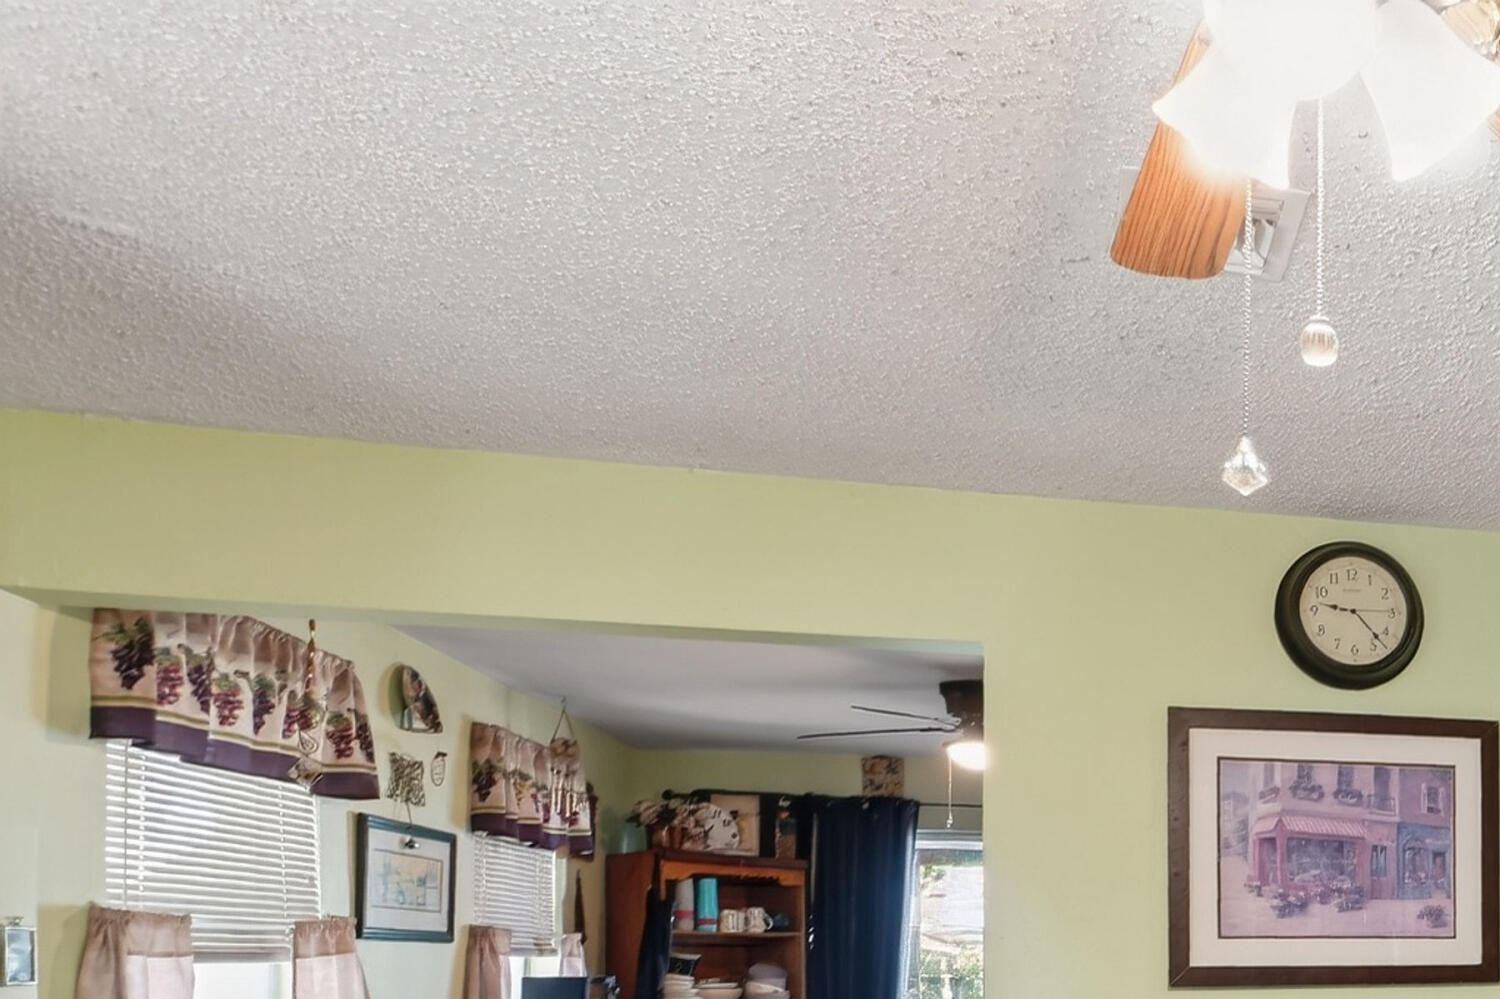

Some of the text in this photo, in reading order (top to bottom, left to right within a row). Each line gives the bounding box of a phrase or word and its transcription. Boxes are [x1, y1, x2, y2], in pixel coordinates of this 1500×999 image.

[1329, 572, 1339, 585] 11
[1346, 569, 1358, 581] 12
[1367, 574, 1373, 586] 1
[1315, 586, 1329, 599] 10
[1381, 587, 1390, 600] 2
[1310, 605, 1319, 616] 9
[1387, 608, 1396, 619] 3
[1317, 624, 1326, 636] 8
[1382, 625, 1390, 637] 4
[1334, 638, 1341, 650] 7
[1350, 644, 1359, 656] 6
